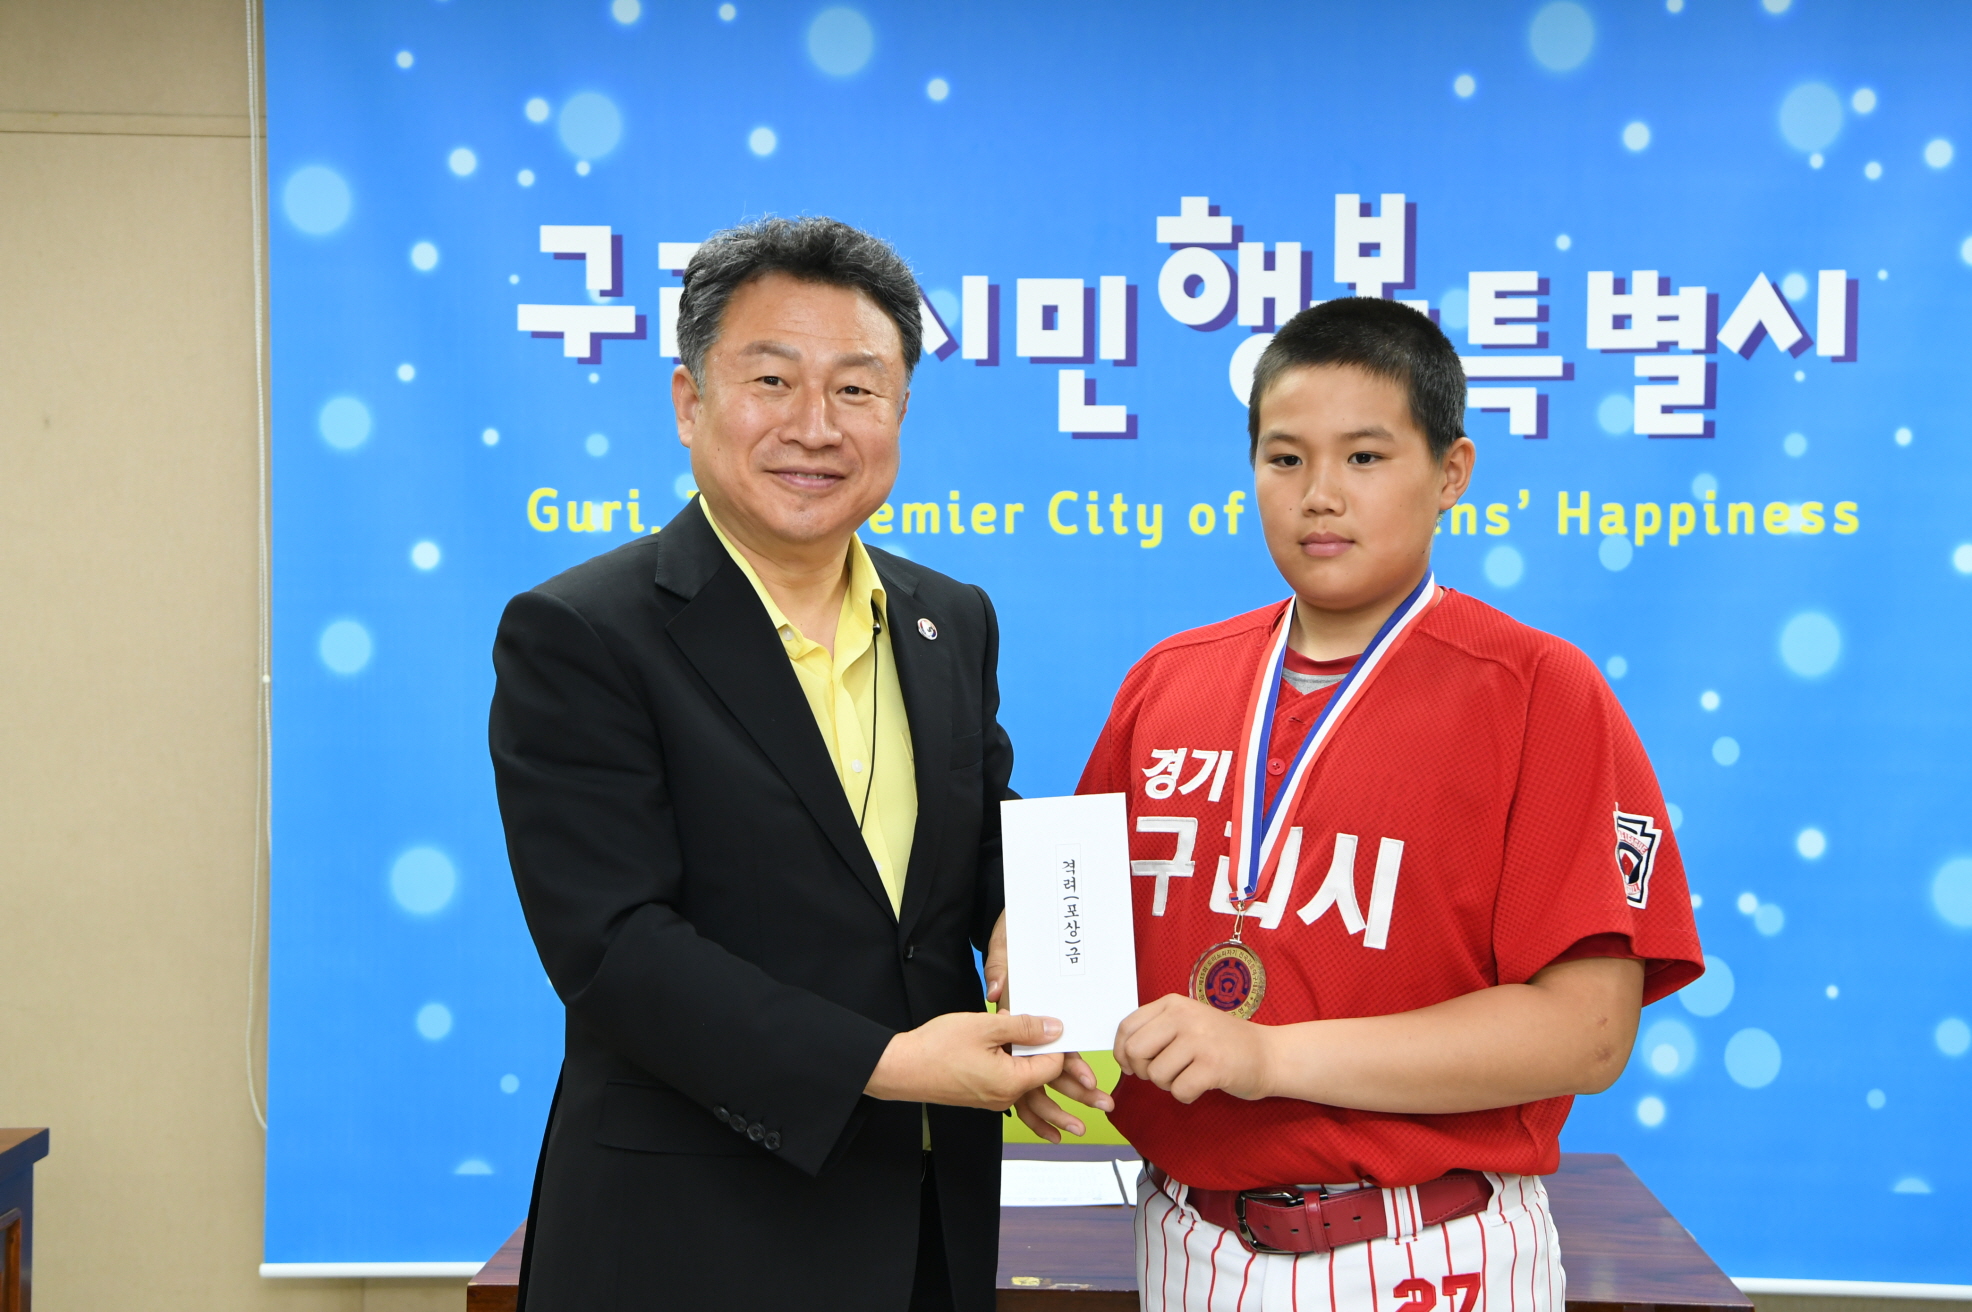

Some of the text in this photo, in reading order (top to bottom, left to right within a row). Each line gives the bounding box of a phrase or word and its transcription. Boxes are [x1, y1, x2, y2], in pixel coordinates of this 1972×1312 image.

[517, 225, 703, 364] 구
[869, 490, 1024, 535] emier
[1048, 490, 1164, 549] City
[1188, 490, 1246, 535] of
[1559, 490, 1861, 546] Happiness
[1142, 748, 1233, 802] 경기
[1062, 859, 1081, 964] 격려(포상)금
[1393, 1272, 1482, 1312] 27
